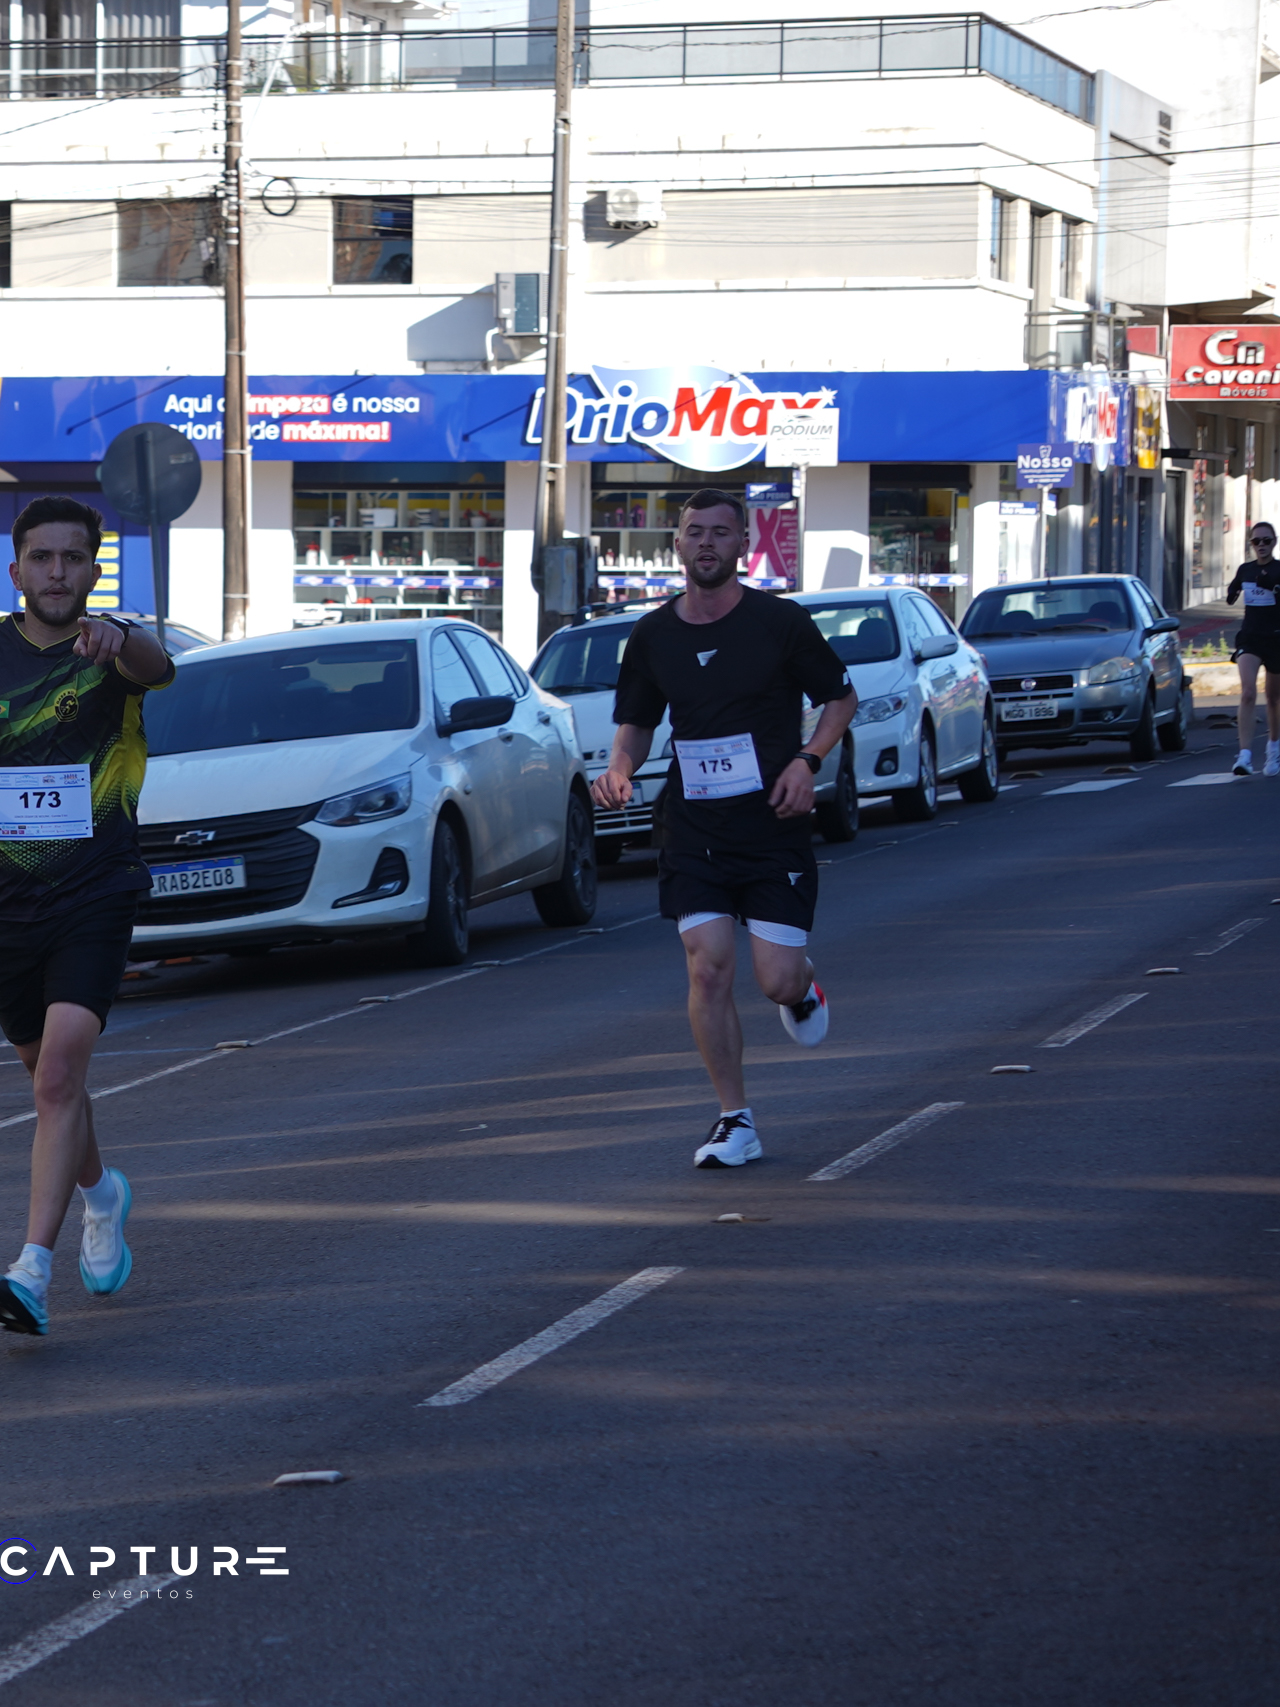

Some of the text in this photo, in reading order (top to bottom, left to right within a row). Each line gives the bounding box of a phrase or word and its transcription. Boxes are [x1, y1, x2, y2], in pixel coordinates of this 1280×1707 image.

[164, 394, 213, 419] Aqui
[246, 393, 330, 418] impeza
[331, 393, 348, 413] é
[352, 398, 420, 413] nossa
[282, 420, 390, 440] máxima!
[770, 425, 833, 436] PODIUM
[1017, 455, 1073, 469] Nossa
[698, 757, 733, 774] 175
[19, 791, 62, 809] 173
[158, 868, 234, 893] RAB2E08
